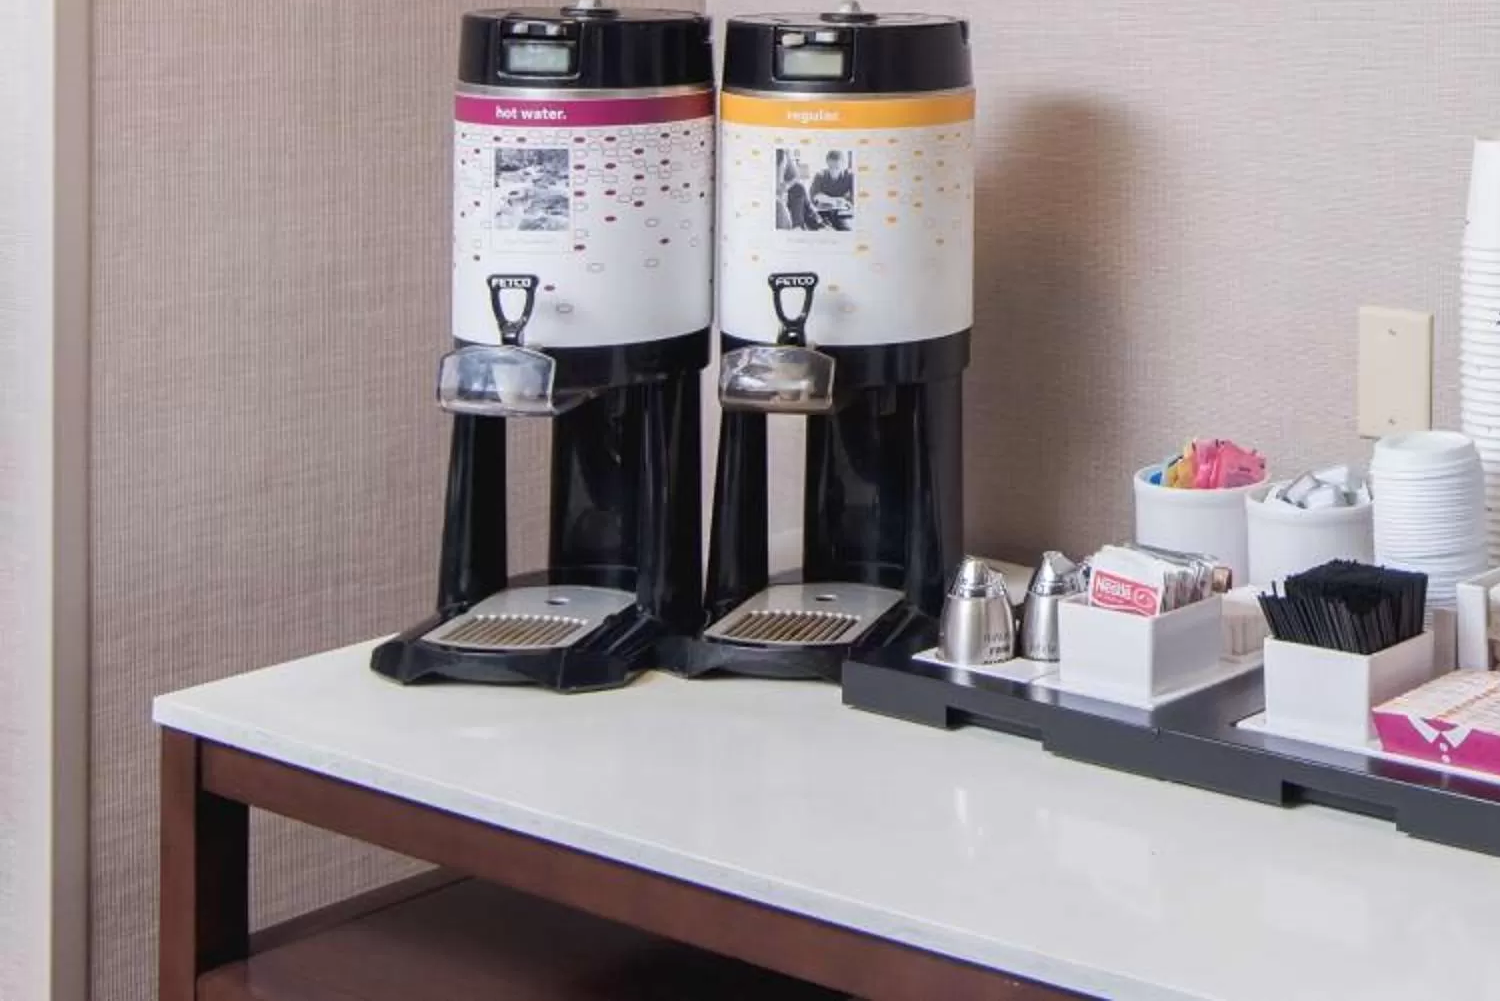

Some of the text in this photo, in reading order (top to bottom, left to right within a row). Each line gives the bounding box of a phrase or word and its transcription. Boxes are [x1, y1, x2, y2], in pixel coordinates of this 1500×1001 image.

[495, 105, 567, 120] hot water.
[491, 278, 531, 289] FETCO
